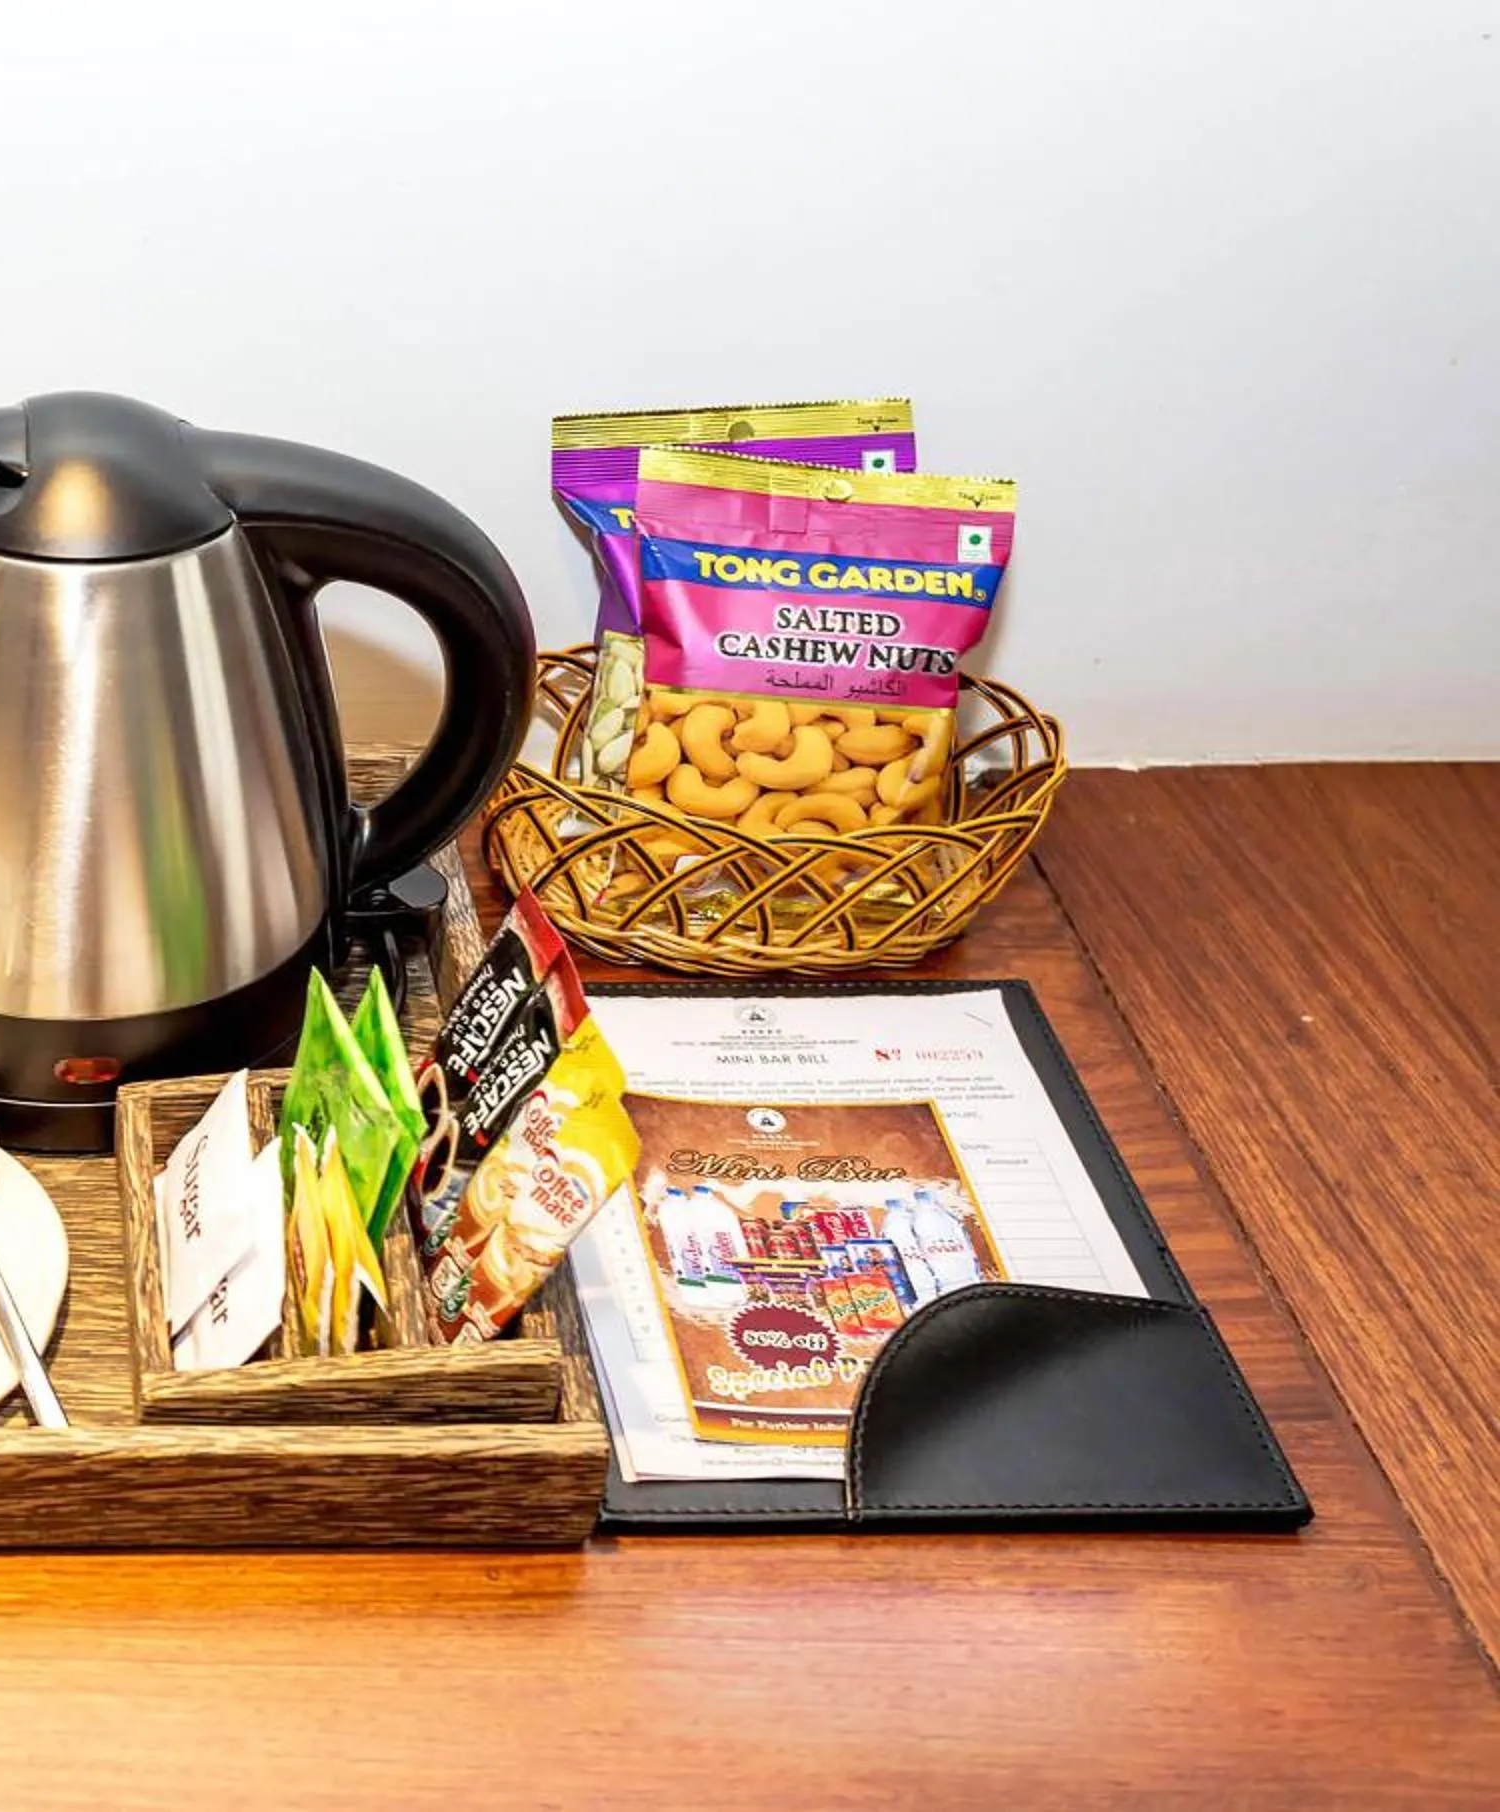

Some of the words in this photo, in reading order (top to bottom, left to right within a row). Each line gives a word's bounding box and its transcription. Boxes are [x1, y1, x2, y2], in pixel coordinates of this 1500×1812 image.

[694, 551, 800, 586] TONG
[809, 563, 973, 599] GARDEN
[776, 607, 901, 636] SALTED
[718, 634, 861, 665] CASHEW
[867, 645, 956, 675] NUTS
[715, 1053, 755, 1065] MINI
[760, 1054, 792, 1065] BAR
[798, 1054, 829, 1065] BILL
[667, 1149, 786, 1180] Mini
[797, 1156, 908, 1182] Bar
[180, 1135, 209, 1243] Sugar
[793, 1335, 828, 1350] off
[708, 1358, 832, 1400] Special
